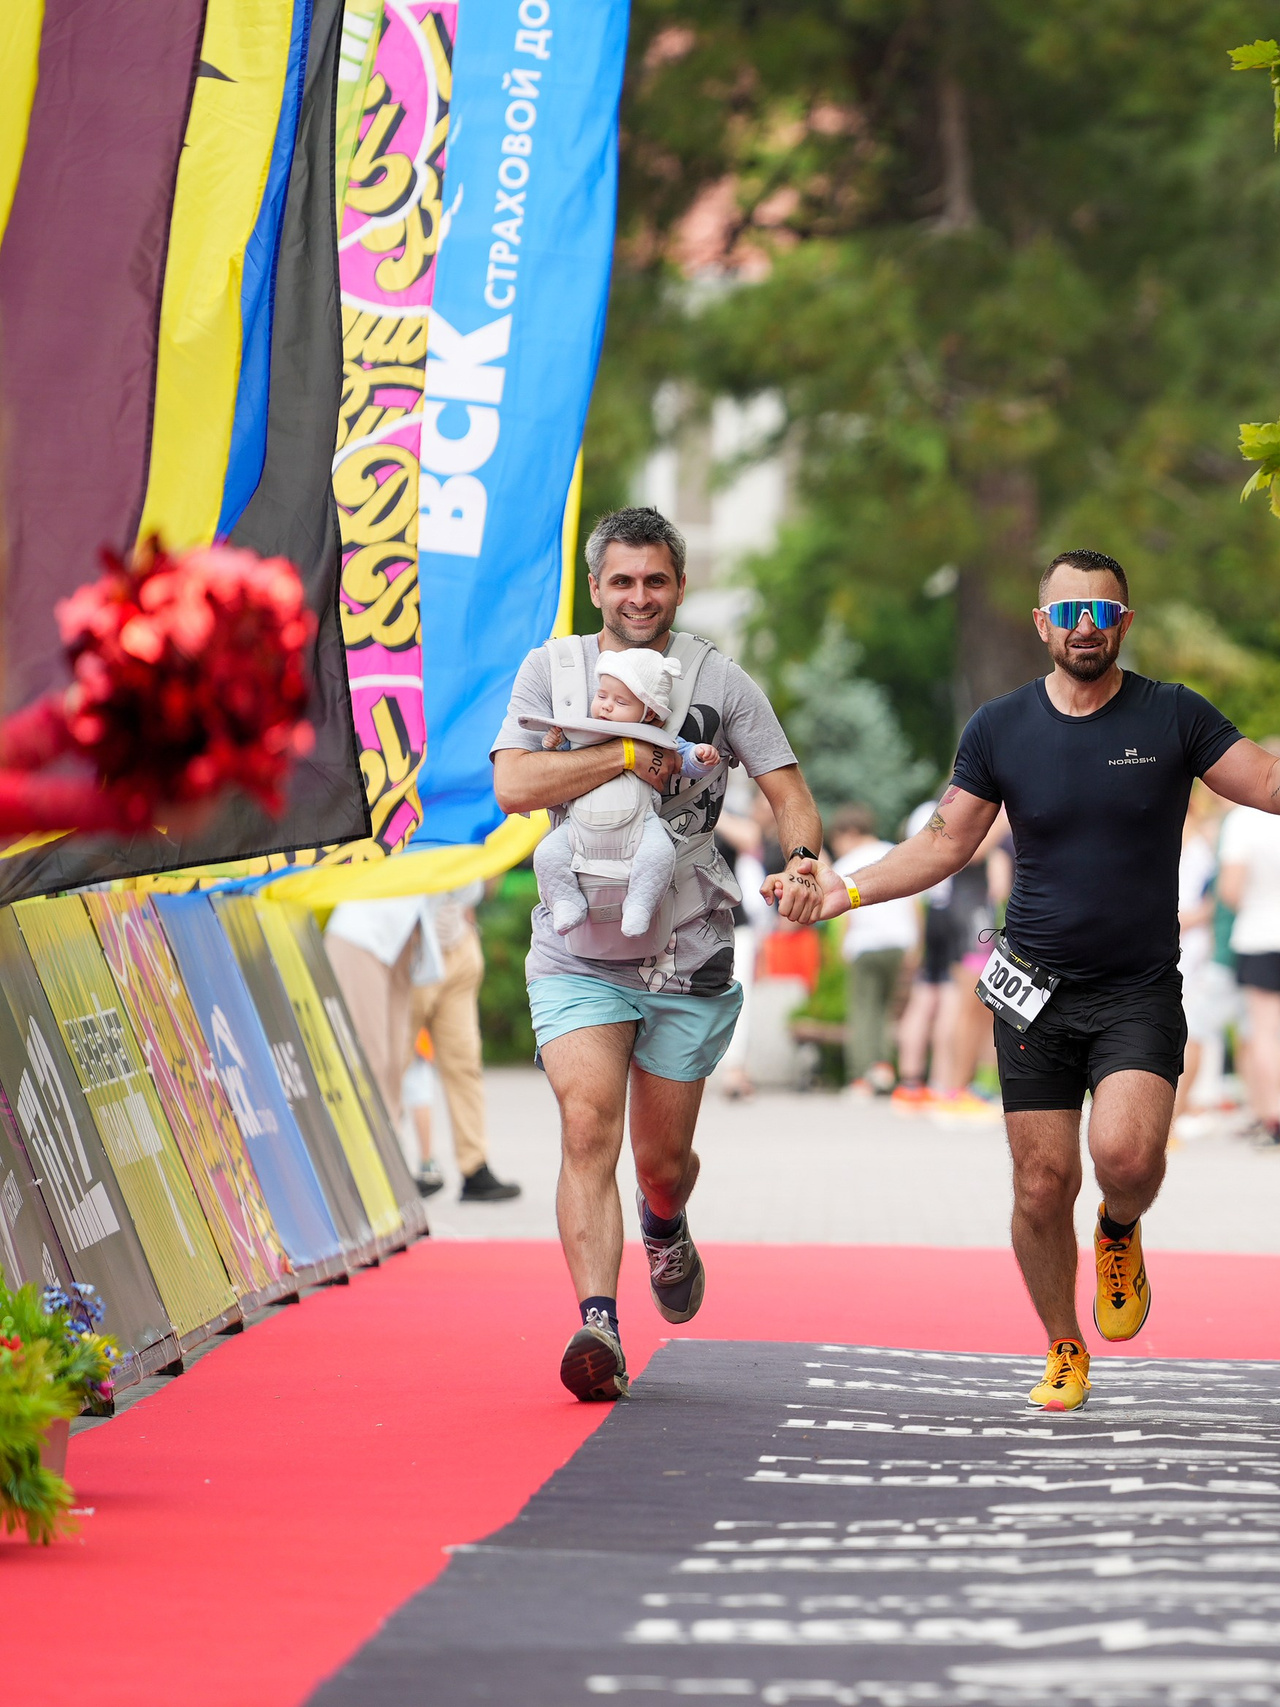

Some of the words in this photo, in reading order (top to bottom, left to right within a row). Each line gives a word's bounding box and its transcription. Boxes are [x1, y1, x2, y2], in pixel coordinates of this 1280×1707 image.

[484, 68, 542, 310] СТРАХОВОЙ
[417, 308, 512, 557] ВСК
[1108, 756, 1156, 766] NORDSKI
[789, 873, 817, 892] 2001
[985, 993, 1004, 1011] DMITRY
[988, 959, 1034, 1007] 2001
[17, 1014, 121, 1254] TELE2
